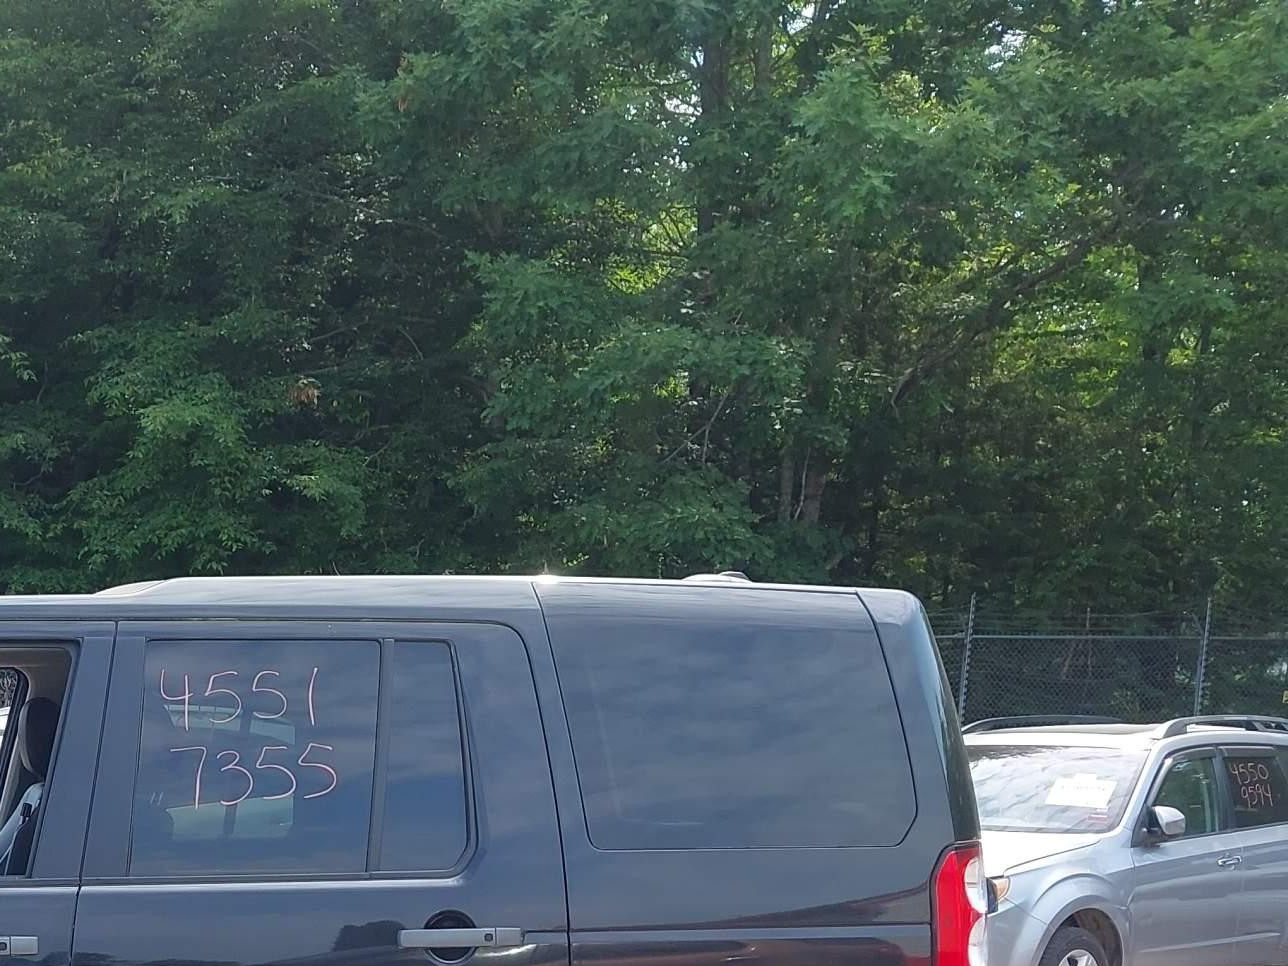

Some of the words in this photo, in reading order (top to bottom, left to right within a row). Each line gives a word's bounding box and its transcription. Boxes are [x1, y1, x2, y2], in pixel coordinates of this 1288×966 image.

[160, 666, 319, 732] 4551
[169, 742, 338, 810] 7355
[1228, 762, 1270, 785] 4550
[1240, 783, 1274, 808] 9594
